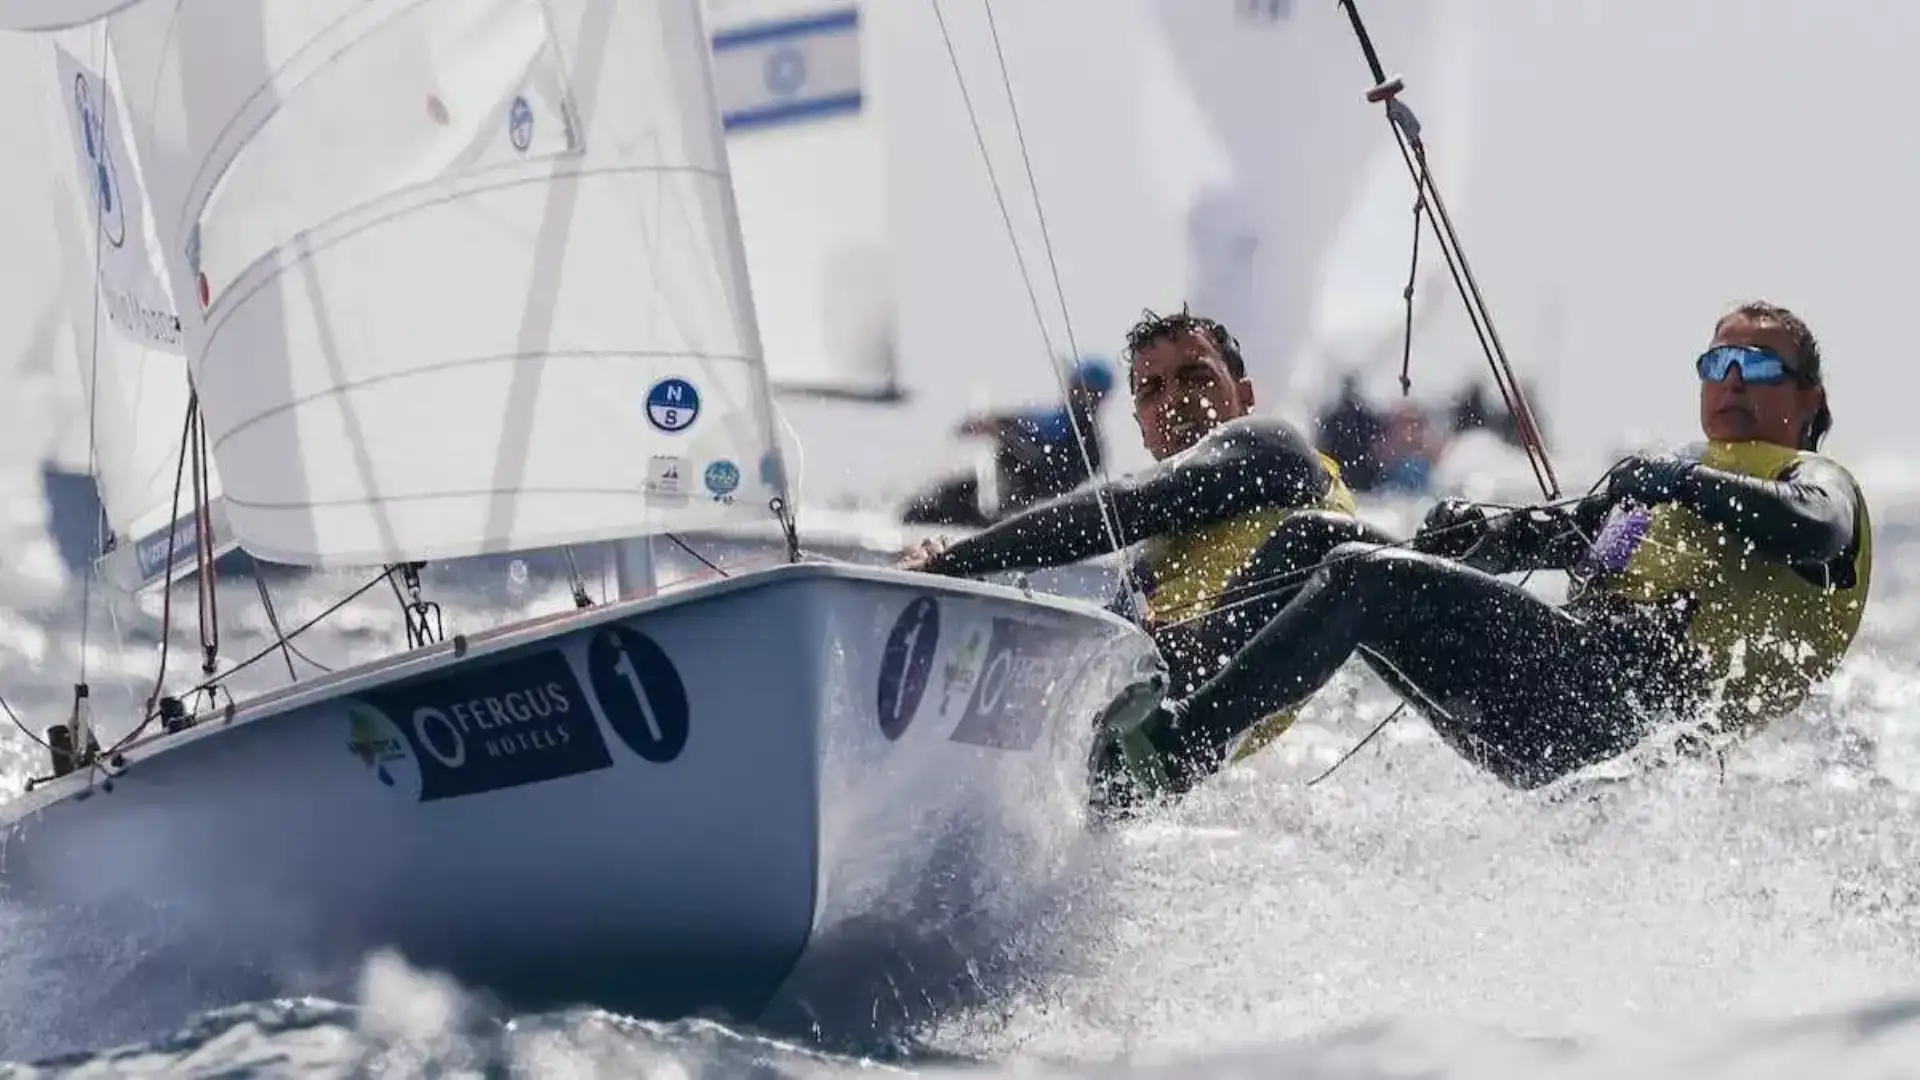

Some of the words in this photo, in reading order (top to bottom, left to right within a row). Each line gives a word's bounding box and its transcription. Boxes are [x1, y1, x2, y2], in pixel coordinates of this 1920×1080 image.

[666, 385, 683, 402] N
[664, 409, 678, 426] S
[453, 682, 571, 733] FERGUS
[483, 724, 571, 758] HOTELS
